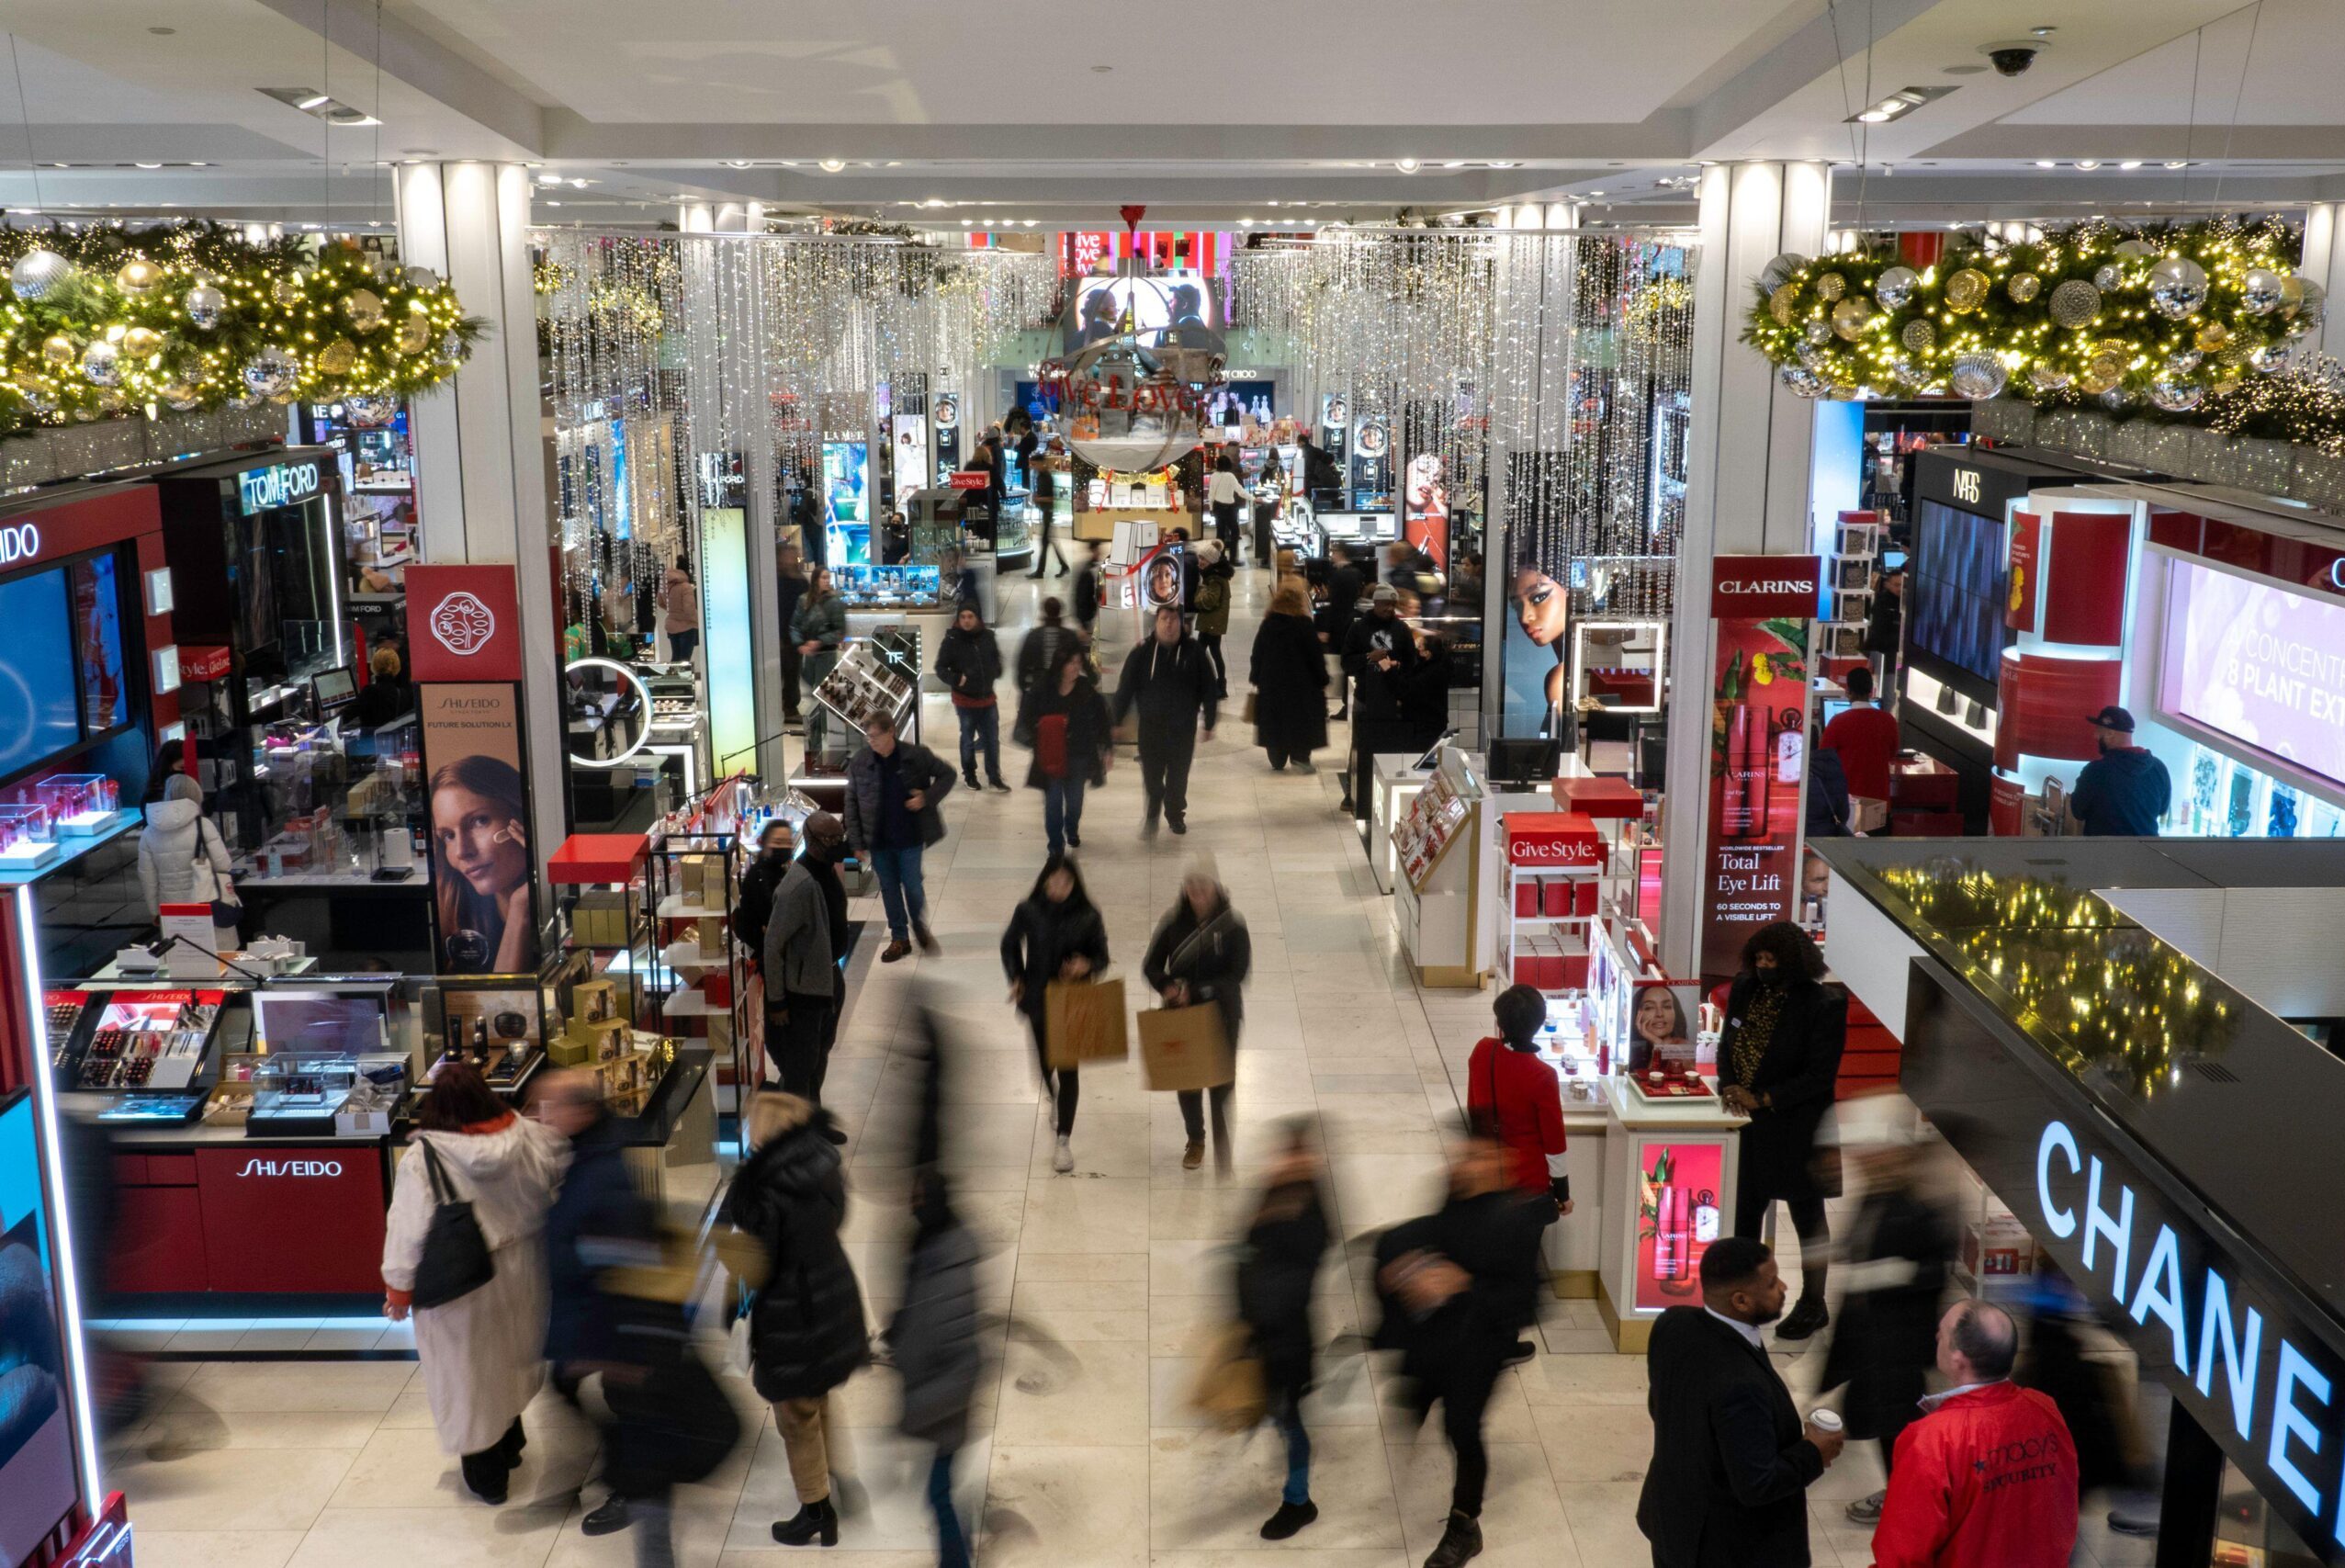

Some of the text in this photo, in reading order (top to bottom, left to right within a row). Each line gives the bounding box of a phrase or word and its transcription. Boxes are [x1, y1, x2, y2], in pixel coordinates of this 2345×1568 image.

[1109, 373, 1195, 412] Love
[247, 463, 318, 507] TOM FORD
[1953, 468, 1980, 503] NARS
[0, 523, 39, 564] IDO
[1719, 580, 1813, 593] CLARINS
[360, 604, 382, 613] FORD
[885, 651, 904, 663] TF
[2246, 628, 2345, 691] CONCENT
[2227, 658, 2239, 686] 8
[2243, 662, 2306, 710] PLANT
[436, 698, 501, 709] SHISEIDO
[1512, 840, 1595, 861] Give Style.
[1719, 853, 1760, 870] Total
[1718, 874, 1781, 896] Eye Lift
[236, 1158, 342, 1177] SHISEIDO
[2036, 1120, 2345, 1552] CHANE
